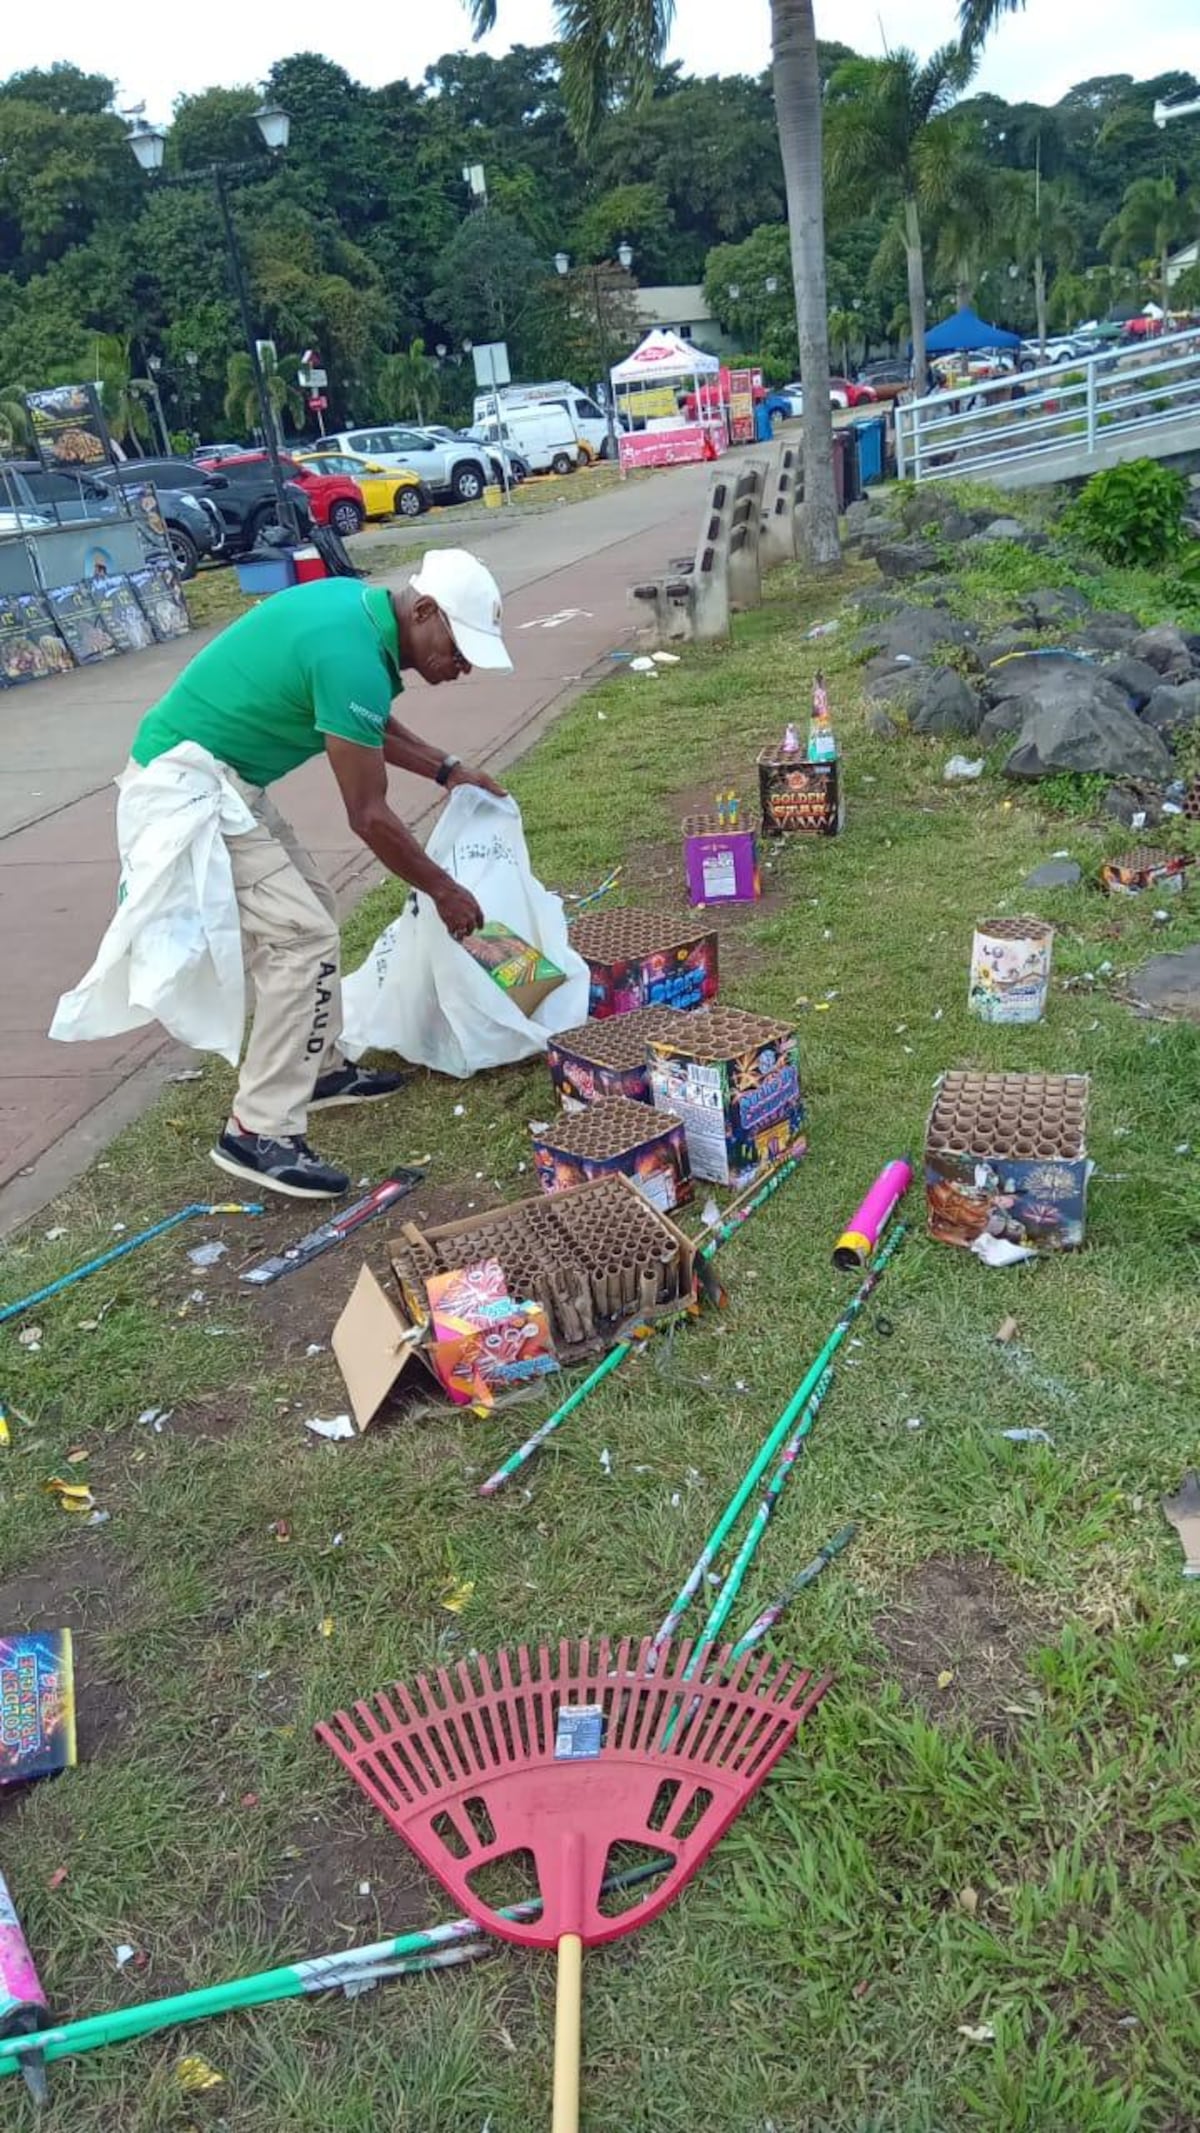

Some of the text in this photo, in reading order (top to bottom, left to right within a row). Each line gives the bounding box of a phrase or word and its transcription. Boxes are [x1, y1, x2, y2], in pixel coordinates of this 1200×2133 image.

[771, 792, 827, 805] GOLDEN
[774, 804, 826, 818] STAR
[304, 961, 337, 1061] A.A.U.D.
[3, 1669, 19, 1741] GOLDEN
[19, 1657, 36, 1748] TRIANGLE
